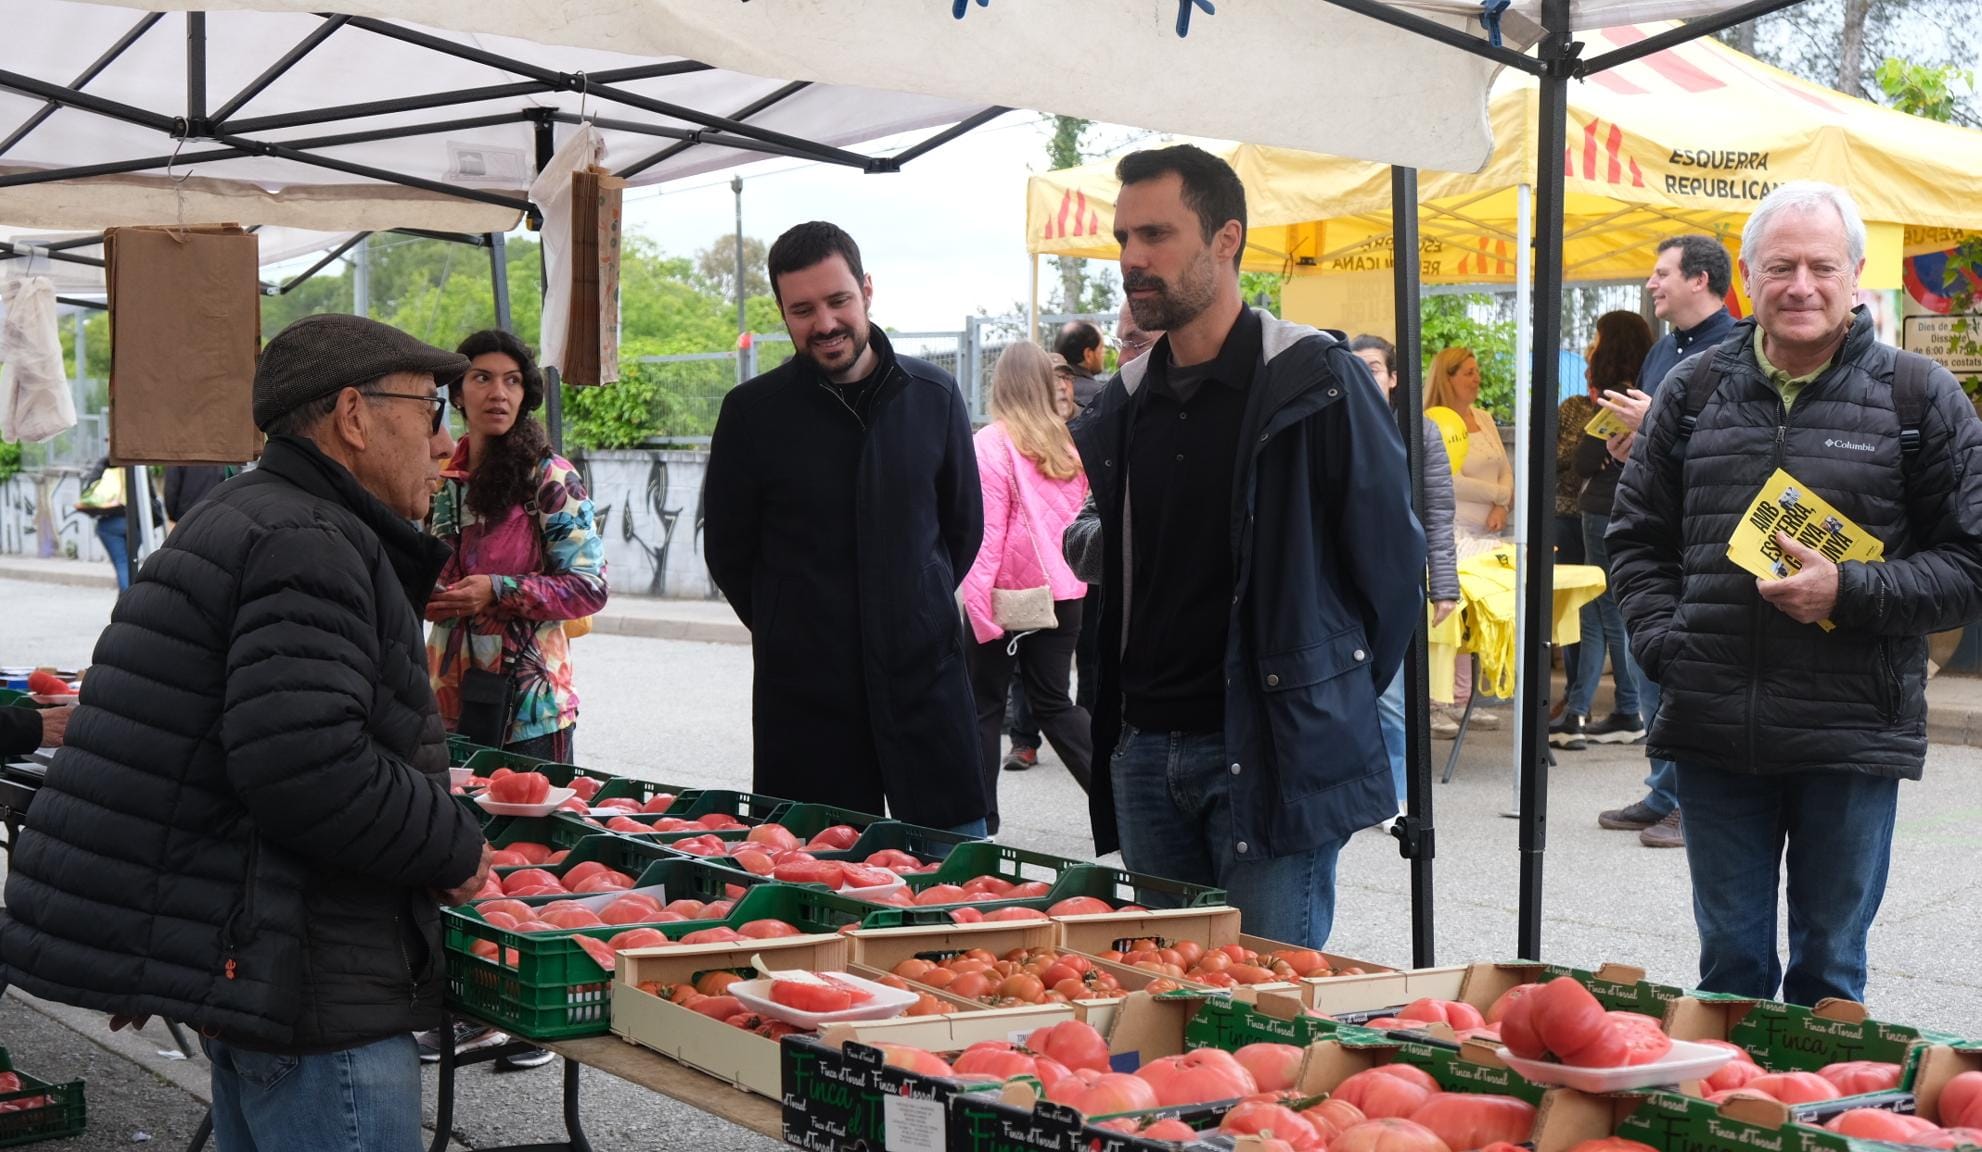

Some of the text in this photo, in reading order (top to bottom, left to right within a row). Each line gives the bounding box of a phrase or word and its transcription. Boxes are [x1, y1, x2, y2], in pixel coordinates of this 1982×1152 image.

[1669, 149, 1769, 171] ESQUERRA
[1665, 174, 1785, 200] REPUBLICA
[1918, 322, 1935, 332] Dies
[1938, 322, 1948, 332] de
[1834, 439, 1875, 452] Columbia
[1750, 500, 1780, 534] AMB
[1761, 1014, 1828, 1055] Finca
[789, 1051, 854, 1110] Finca
[871, 1070, 898, 1094] Finca
[1707, 1119, 1737, 1140] Finca
